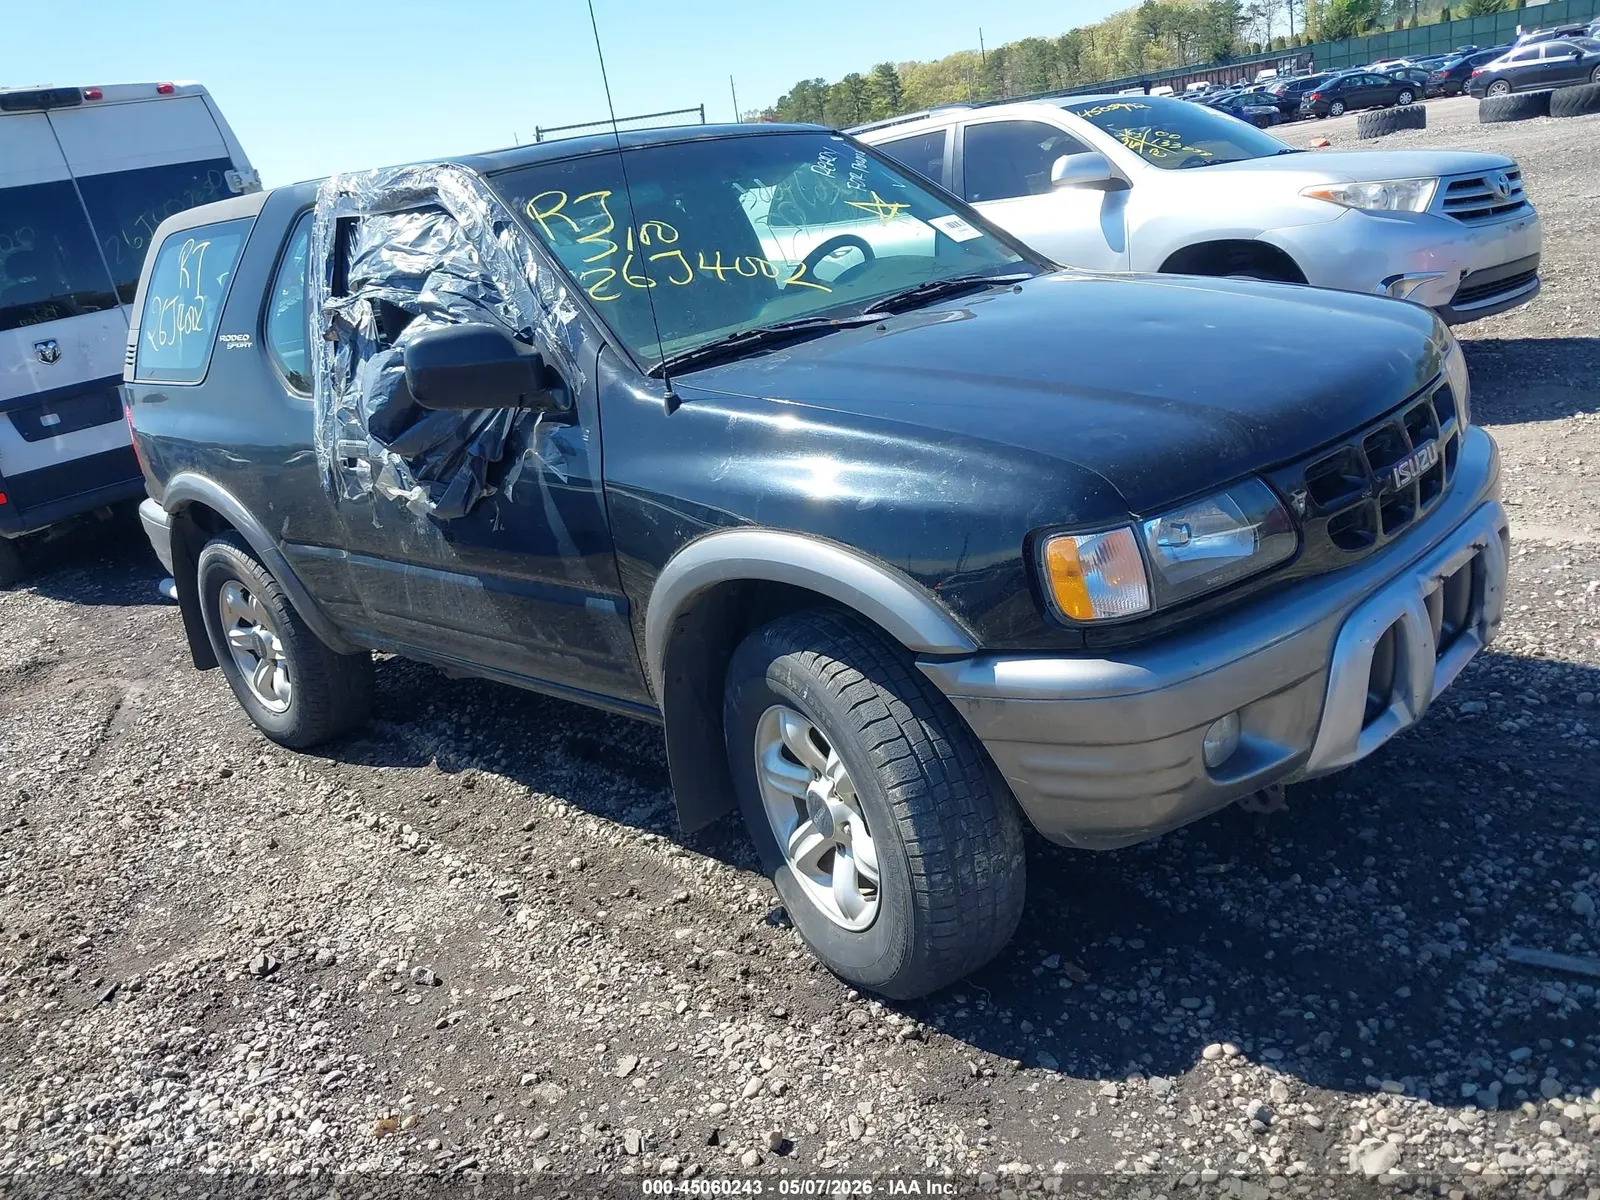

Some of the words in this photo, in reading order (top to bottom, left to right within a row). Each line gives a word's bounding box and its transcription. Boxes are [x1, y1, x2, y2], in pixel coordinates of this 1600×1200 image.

[579, 249, 833, 301] 26J4002
[219, 333, 250, 342] RODEO
[226, 342, 253, 350] SPORT
[1392, 442, 1438, 489] ISUZU
